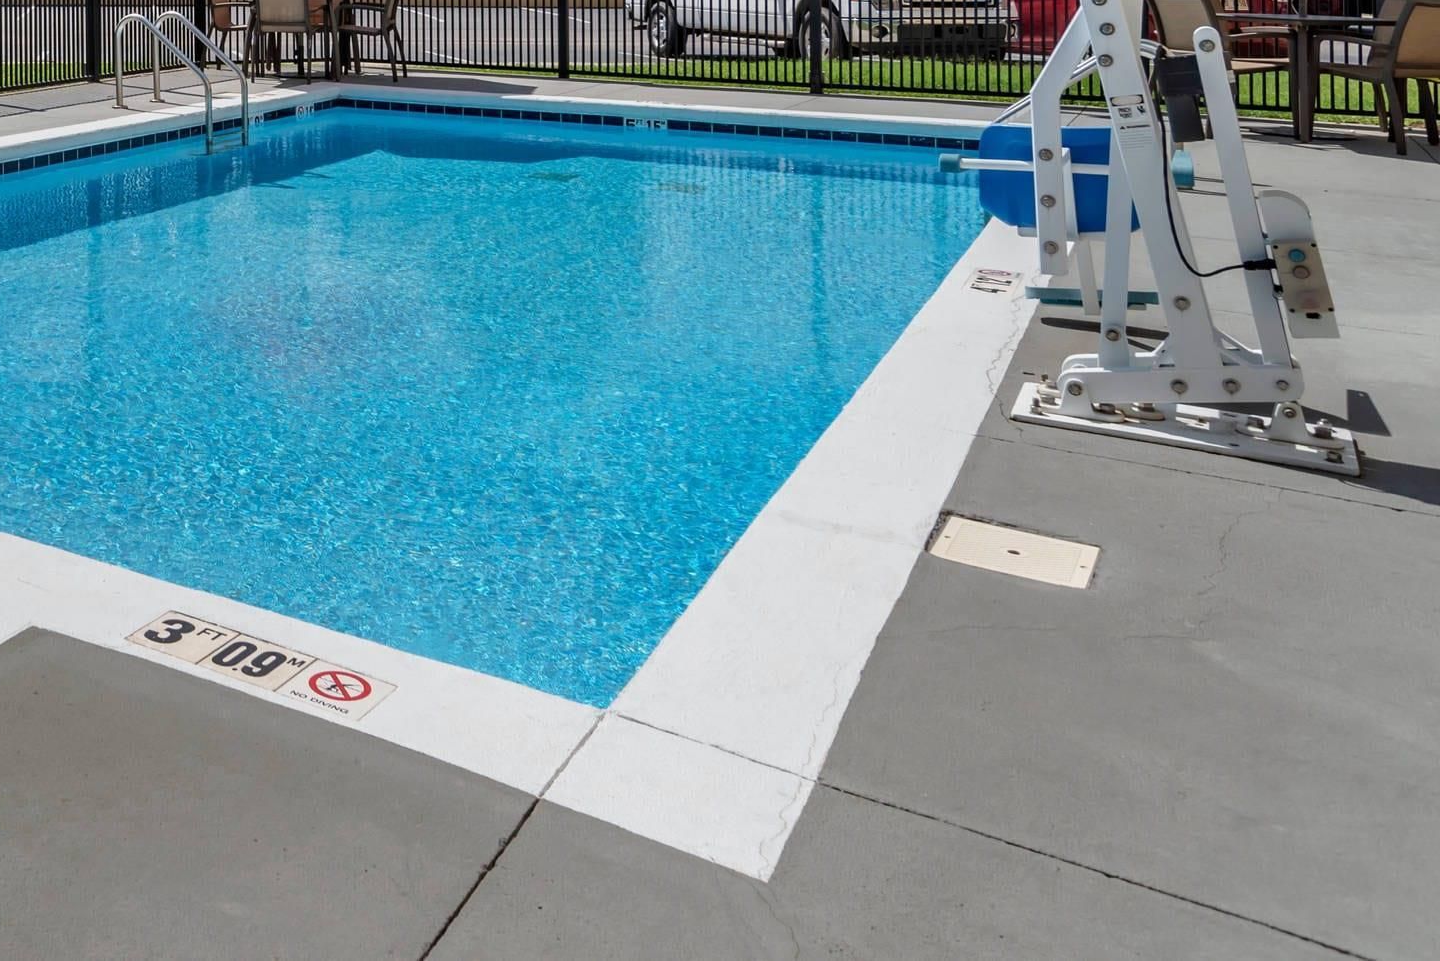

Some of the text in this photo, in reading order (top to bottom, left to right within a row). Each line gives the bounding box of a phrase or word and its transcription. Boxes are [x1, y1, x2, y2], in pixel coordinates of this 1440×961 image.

[144, 619, 306, 678] 3 FT 0.9 M
[290, 689, 349, 714] NO DIVING
